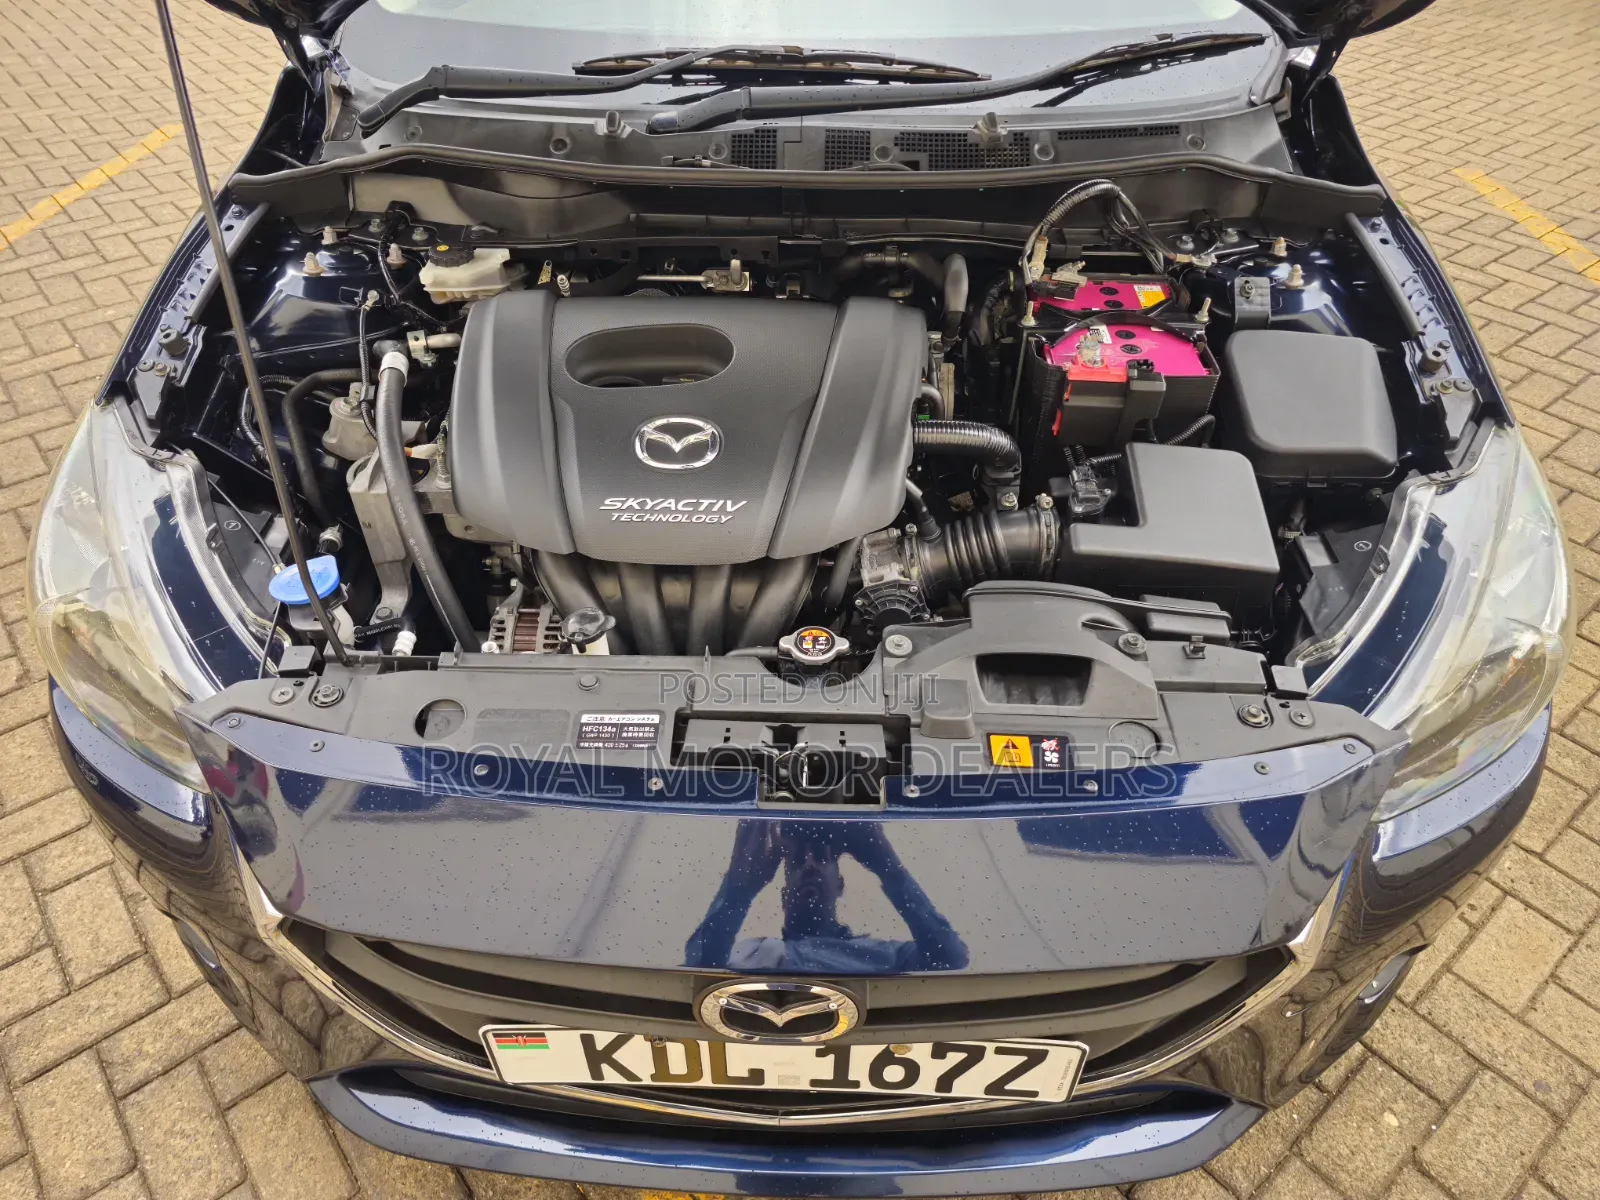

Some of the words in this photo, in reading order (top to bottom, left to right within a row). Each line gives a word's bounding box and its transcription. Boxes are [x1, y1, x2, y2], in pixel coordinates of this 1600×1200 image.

[599, 496, 747, 512] SKYACTIV
[610, 512, 734, 525] TECHNOLOGY
[580, 1033, 765, 1086] KDL
[809, 1042, 1050, 1098] 167Z
